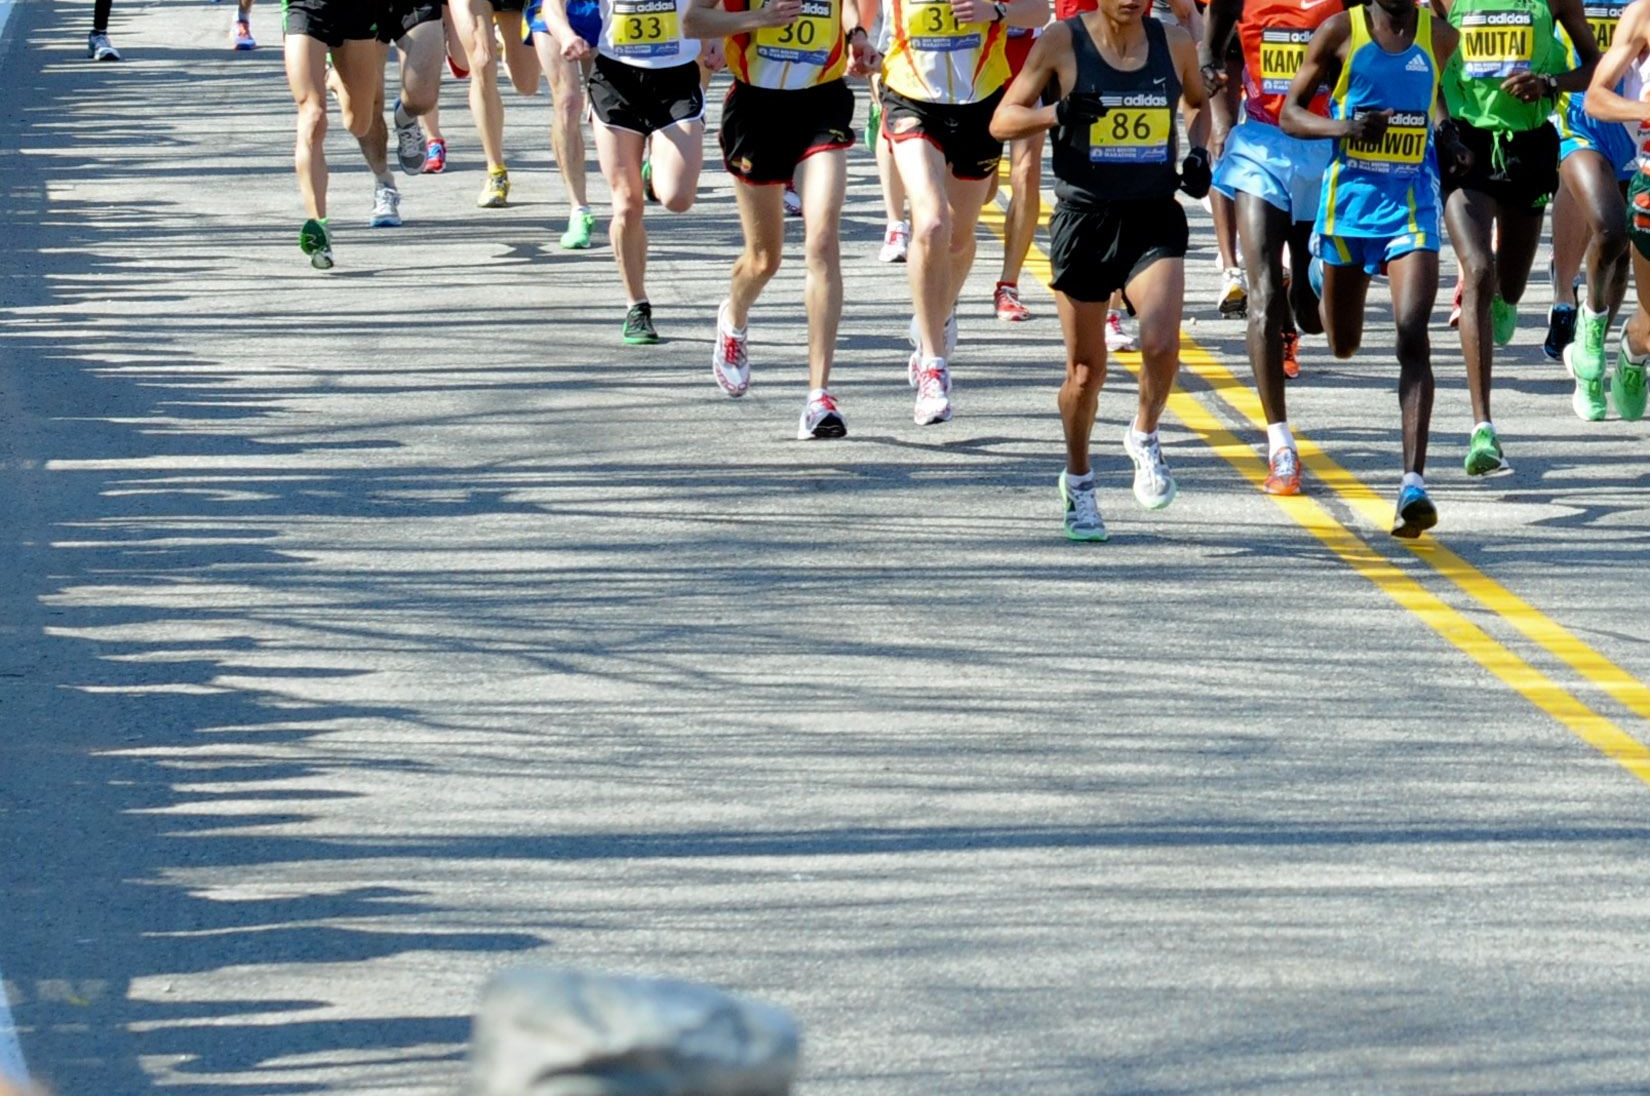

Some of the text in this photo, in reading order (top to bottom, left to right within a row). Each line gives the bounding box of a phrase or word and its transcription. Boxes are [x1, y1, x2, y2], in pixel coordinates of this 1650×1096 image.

[636, 1, 677, 14] adidas
[1486, 12, 1531, 25] adidas
[628, 16, 662, 40] 33
[777, 19, 816, 45] 30
[1464, 31, 1527, 58] MUTAI
[1263, 49, 1305, 74] KAM
[1123, 94, 1169, 107] adidas
[1111, 112, 1151, 141] 86
[1388, 113, 1426, 126] didas
